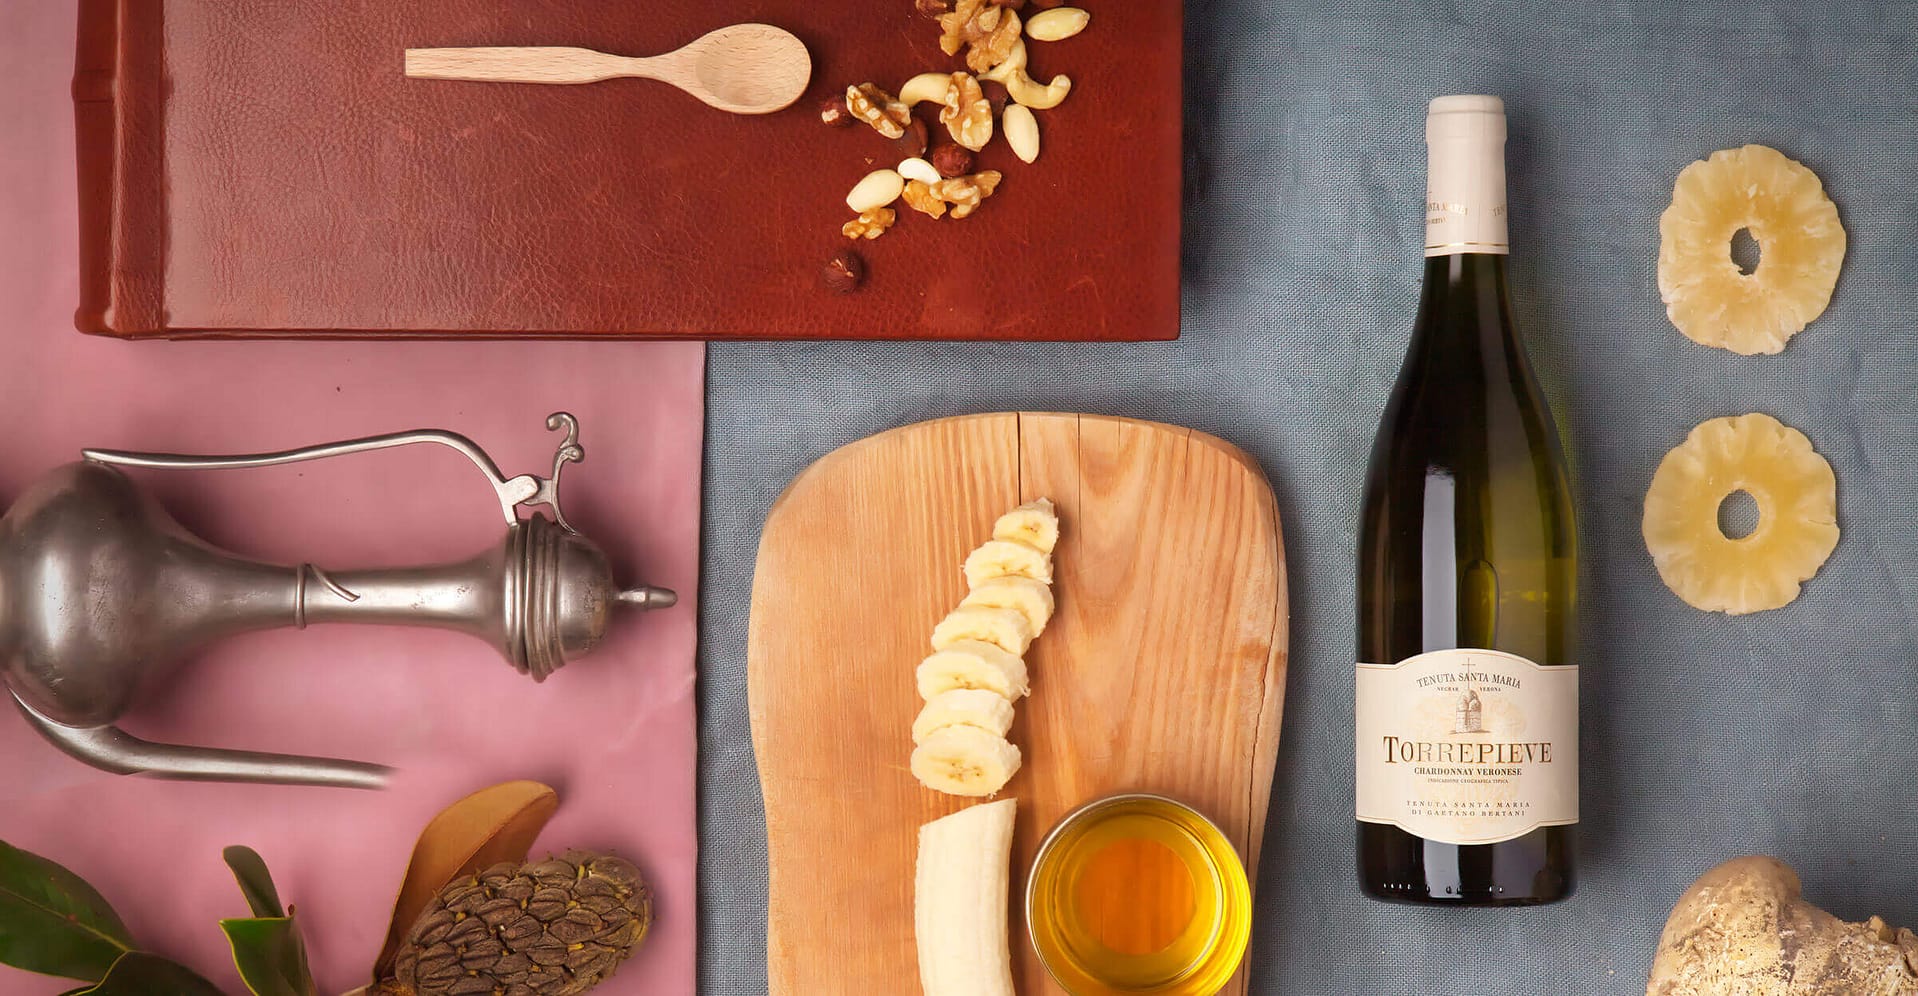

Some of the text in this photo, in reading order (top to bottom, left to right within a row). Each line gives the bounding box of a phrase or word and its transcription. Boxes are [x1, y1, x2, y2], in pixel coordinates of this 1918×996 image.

[1416, 672, 1521, 689] TENUTA SANTA MARIA
[1383, 736, 1552, 764] TORREPIEVE
[1414, 767, 1522, 776] CHARDONNAY VERONESE
[1406, 800, 1447, 808] TENUTA
